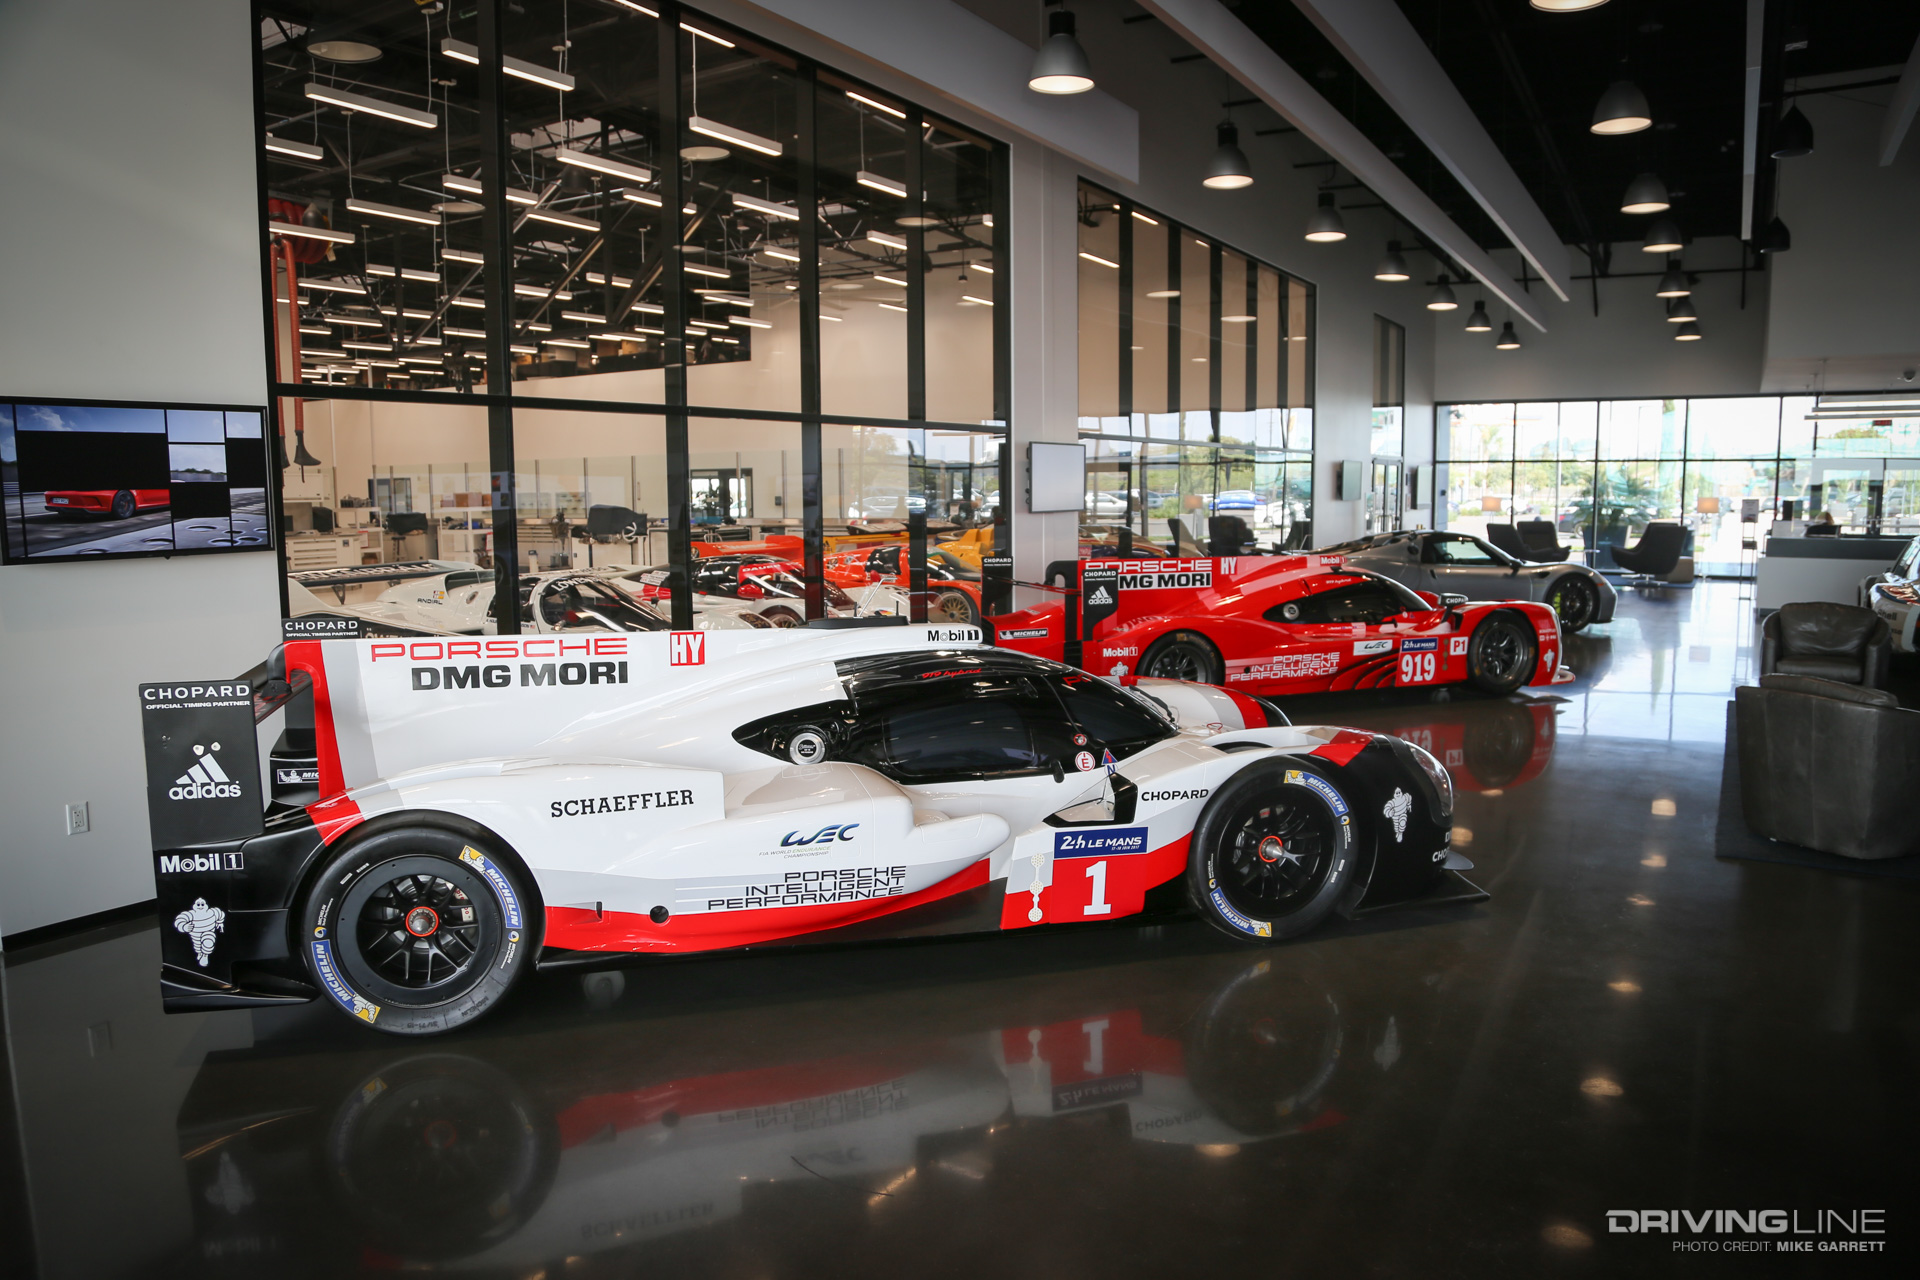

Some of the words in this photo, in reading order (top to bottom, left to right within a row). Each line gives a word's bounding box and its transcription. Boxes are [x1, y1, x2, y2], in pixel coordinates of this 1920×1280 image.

[742, 563, 781, 572] DAUER
[1220, 557, 1237, 575] HY
[1320, 556, 1340, 564] Mobil
[1118, 574, 1153, 589] MG
[1157, 572, 1211, 587] MORI
[1088, 597, 1113, 605] adidas
[284, 620, 358, 631] CHOPARD
[927, 630, 965, 642] Mobil
[371, 637, 628, 662] PORSCHE
[670, 634, 704, 665] HY
[1103, 648, 1128, 657] Mobil
[1364, 641, 1388, 650] WEC
[1453, 639, 1466, 652] P1
[1251, 659, 1340, 672] INTELLIGENT
[1273, 652, 1340, 664] PORSCHE
[411, 664, 511, 690] DMG
[520, 661, 628, 687] MORI
[921, 671, 942, 679] 919
[943, 667, 982, 678] hybrid
[1401, 652, 1436, 683] 919
[143, 684, 250, 700] CHOPARD
[145, 702, 181, 710] OFFICIAL
[182, 701, 212, 709] TIMING
[212, 700, 251, 708] PARTNER
[168, 782, 242, 800] adidas
[1141, 789, 1209, 802] CHOPARD
[1307, 776, 1346, 812] MICHELIN
[550, 789, 694, 818] SCHAEFFLER
[780, 823, 860, 847] WEC
[1087, 838, 1104, 848] LE
[1105, 836, 1142, 847] MANS
[160, 853, 221, 873] Mobil
[783, 850, 829, 859] CHAMPIONSHIP
[784, 865, 907, 883] PORSCHE
[745, 876, 906, 896] INTELLIGENT
[1083, 860, 1112, 915] 1
[486, 867, 520, 926] MICHELIN
[708, 886, 904, 910] PERFORMANCE
[1212, 892, 1250, 929] MICHELIN
[315, 944, 351, 1003] MICHELIN
